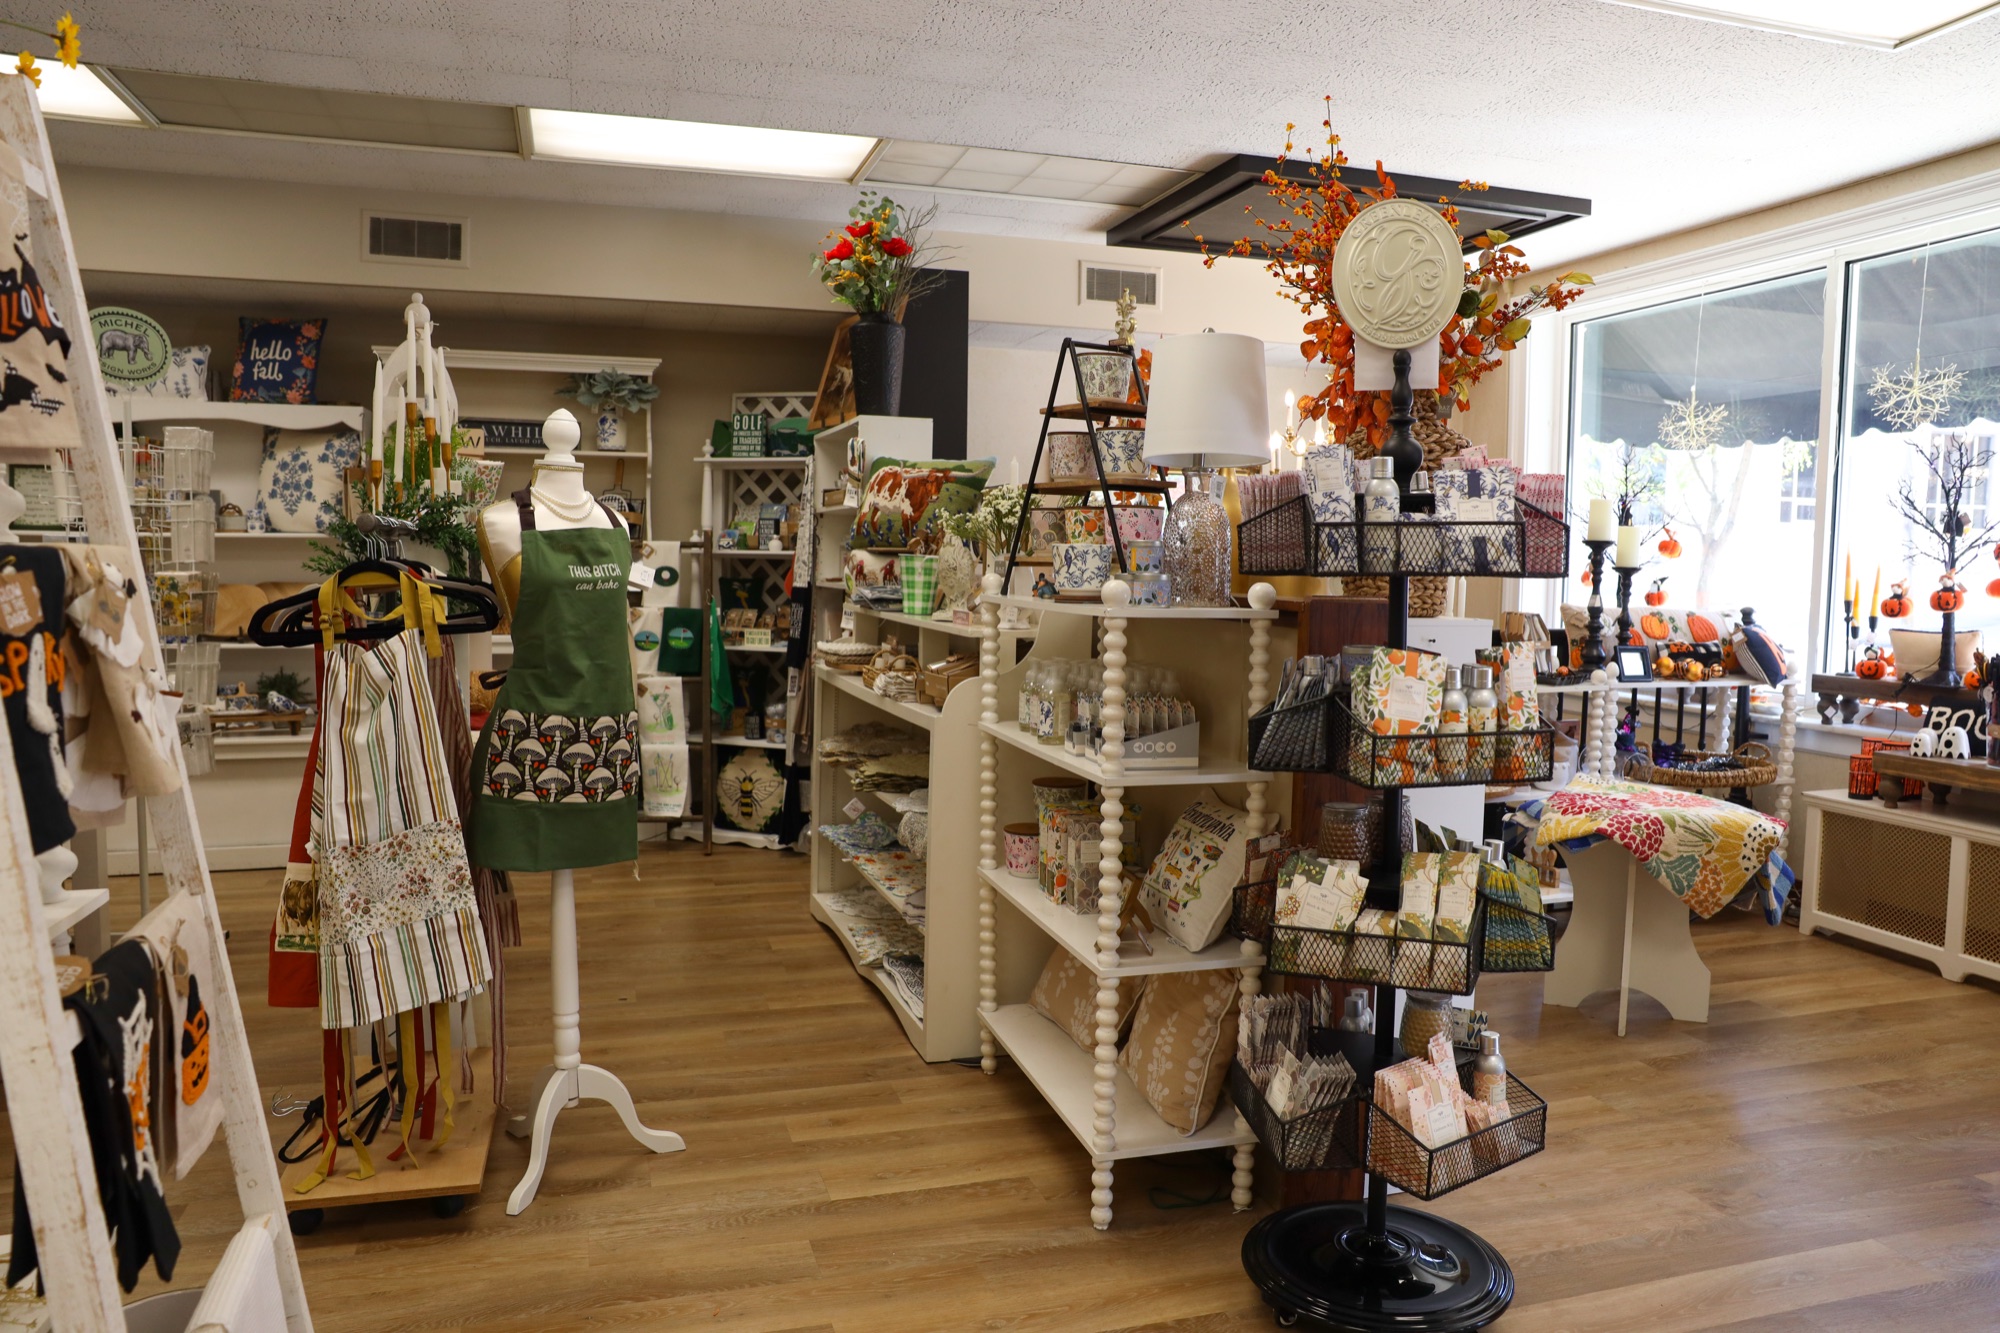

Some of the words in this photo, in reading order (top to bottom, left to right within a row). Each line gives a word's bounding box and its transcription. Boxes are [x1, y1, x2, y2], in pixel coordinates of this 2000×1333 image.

[1350, 204, 1442, 239] GREENLEAF
[99, 319, 150, 338] MICHEL
[250, 339, 292, 361] hello
[101, 361, 124, 375] SIGN
[127, 362, 157, 375] WORKS
[252, 361, 283, 381] fall
[733, 415, 762, 430] GOLF
[568, 565, 592, 578] THIS
[593, 563, 622, 577] BITCH
[575, 582, 593, 591] can
[596, 578, 619, 590] bake
